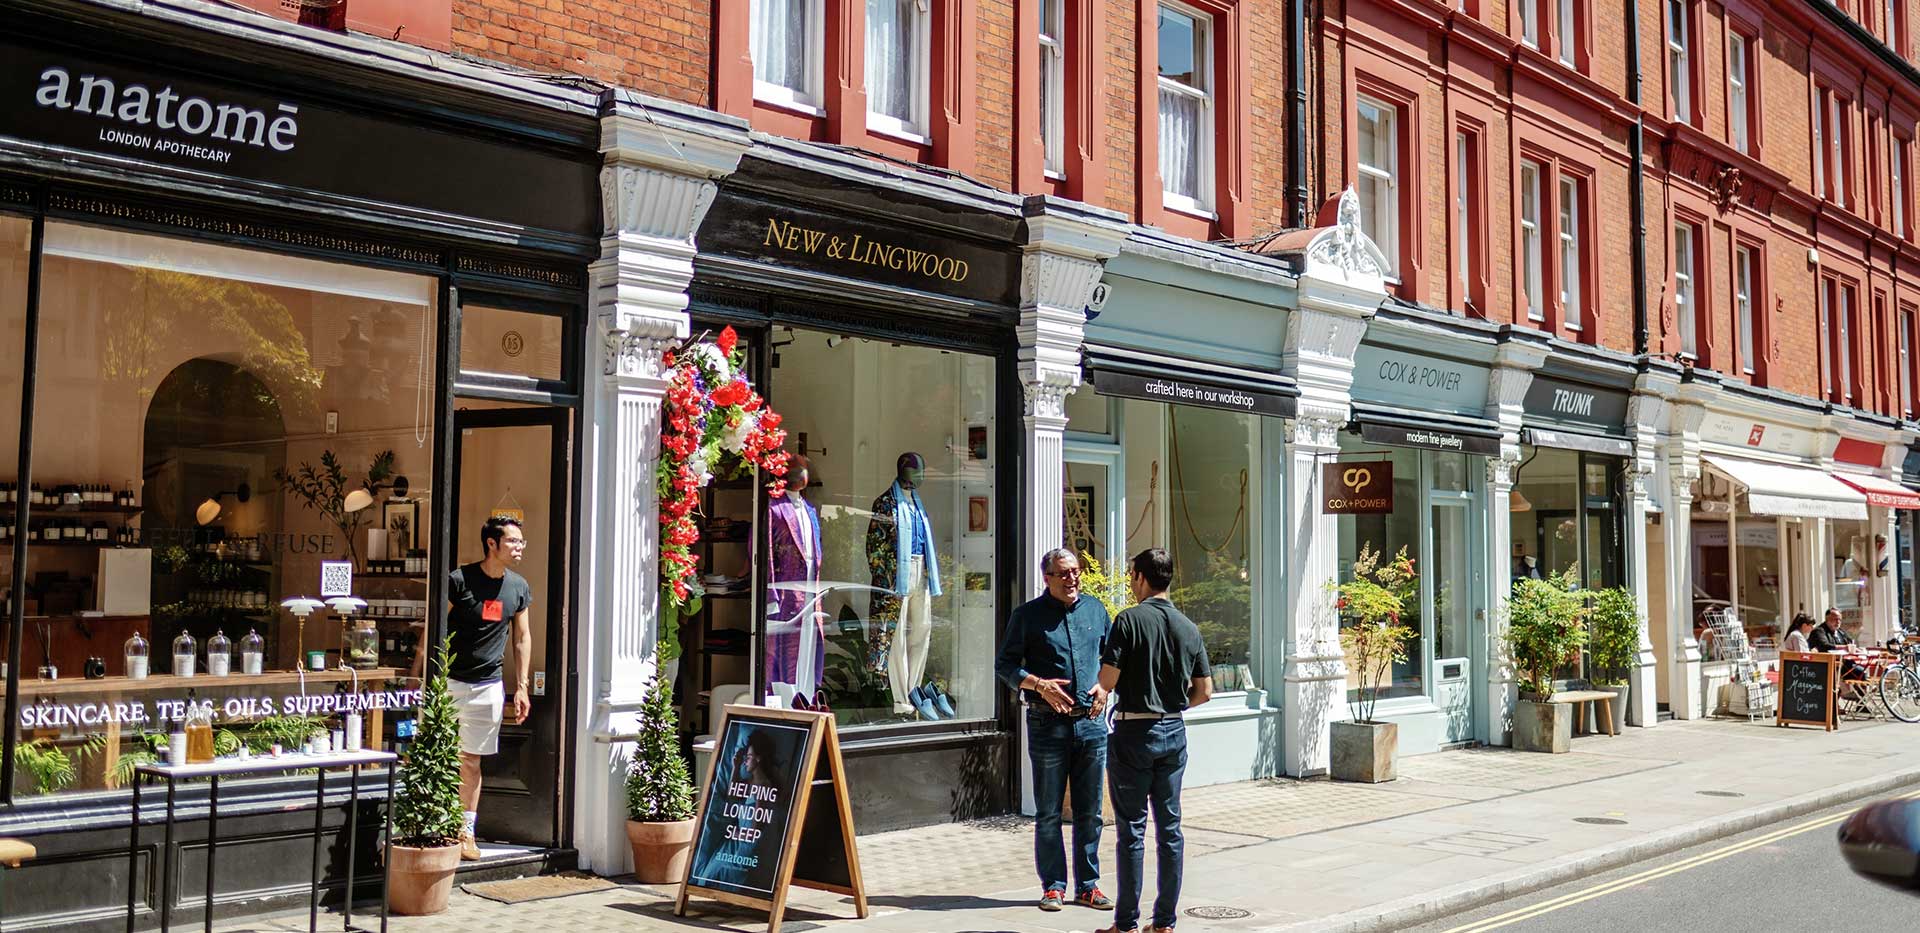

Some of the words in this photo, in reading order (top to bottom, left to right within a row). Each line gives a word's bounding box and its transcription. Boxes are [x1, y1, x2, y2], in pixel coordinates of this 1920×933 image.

[36, 67, 298, 151] anatomē
[100, 128, 151, 149] LONDON
[154, 139, 231, 163] APOTHECARY
[763, 218, 826, 254] NEW
[827, 236, 847, 259] &
[848, 234, 968, 282] LINGWOOD
[1379, 360, 1408, 384] COX
[1408, 366, 1417, 384] &
[1419, 367, 1461, 392] POWER
[1145, 380, 1174, 396] crafted
[1176, 383, 1194, 398] here
[1195, 387, 1203, 400] in
[1204, 391, 1217, 402] our
[1218, 391, 1254, 409] workshop
[1552, 389, 1595, 416] TRUNK
[1406, 431, 1428, 443] modern
[1429, 431, 1440, 445] fine
[1440, 433, 1462, 449] jewellery
[257, 531, 334, 555] REUSE
[20, 701, 150, 728] SKINCARE.
[225, 698, 278, 717] OILS.
[728, 782, 778, 802] HELPING
[723, 802, 773, 824] LONDON
[724, 824, 761, 843] SLEEP
[715, 851, 758, 867] anatomē
